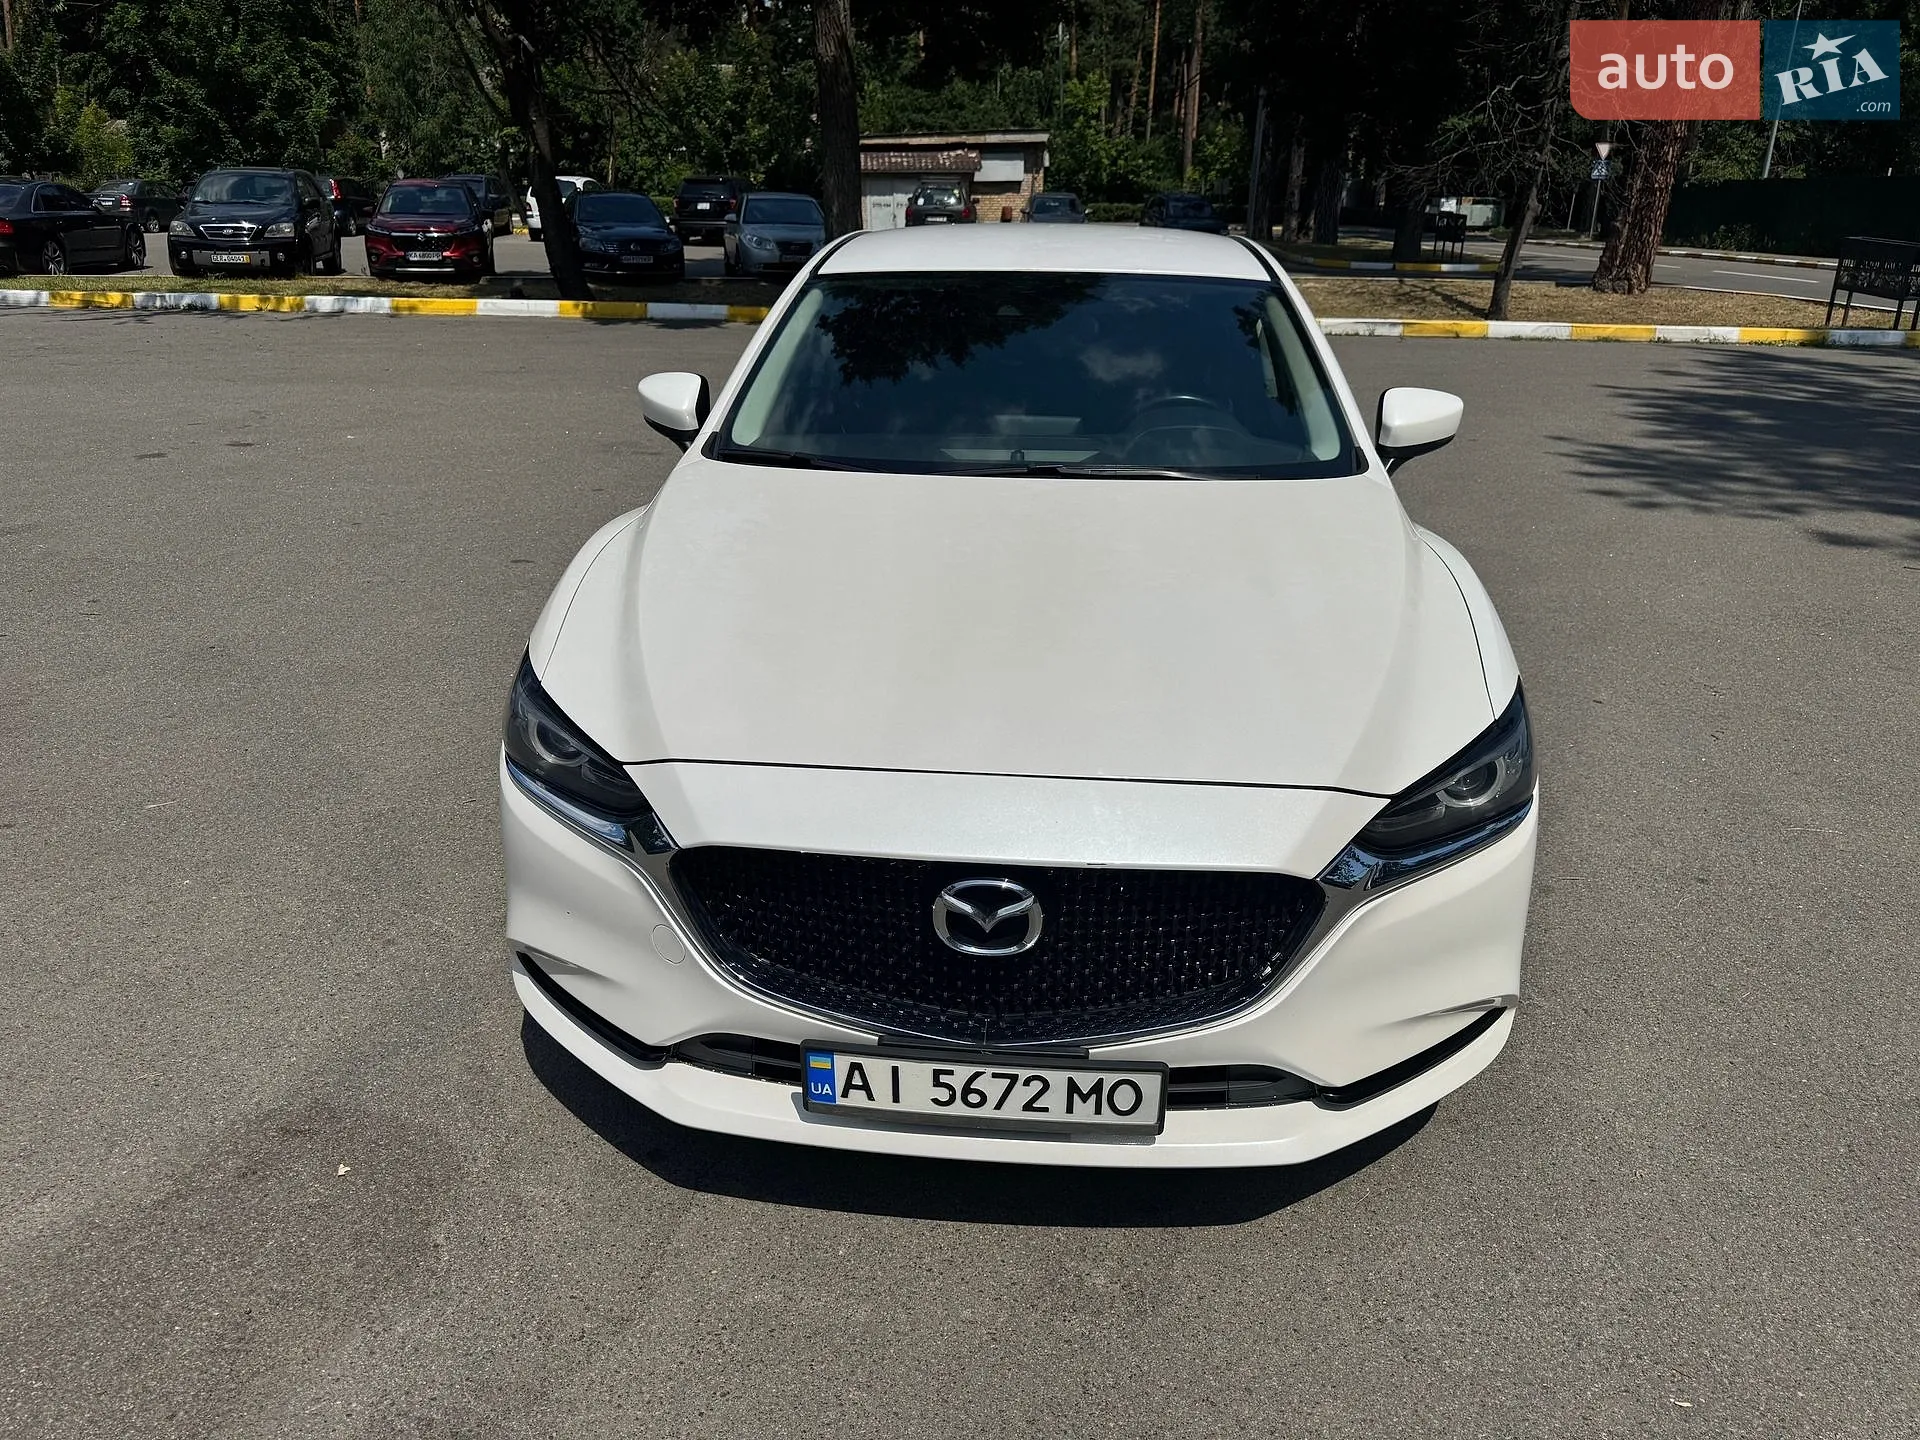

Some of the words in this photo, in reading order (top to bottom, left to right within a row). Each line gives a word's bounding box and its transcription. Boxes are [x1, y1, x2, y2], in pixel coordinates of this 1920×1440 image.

[811, 1082, 832, 1096] UA
[839, 1061, 900, 1104] AI
[930, 1068, 1050, 1113] 5672
[1064, 1075, 1144, 1117] MO
